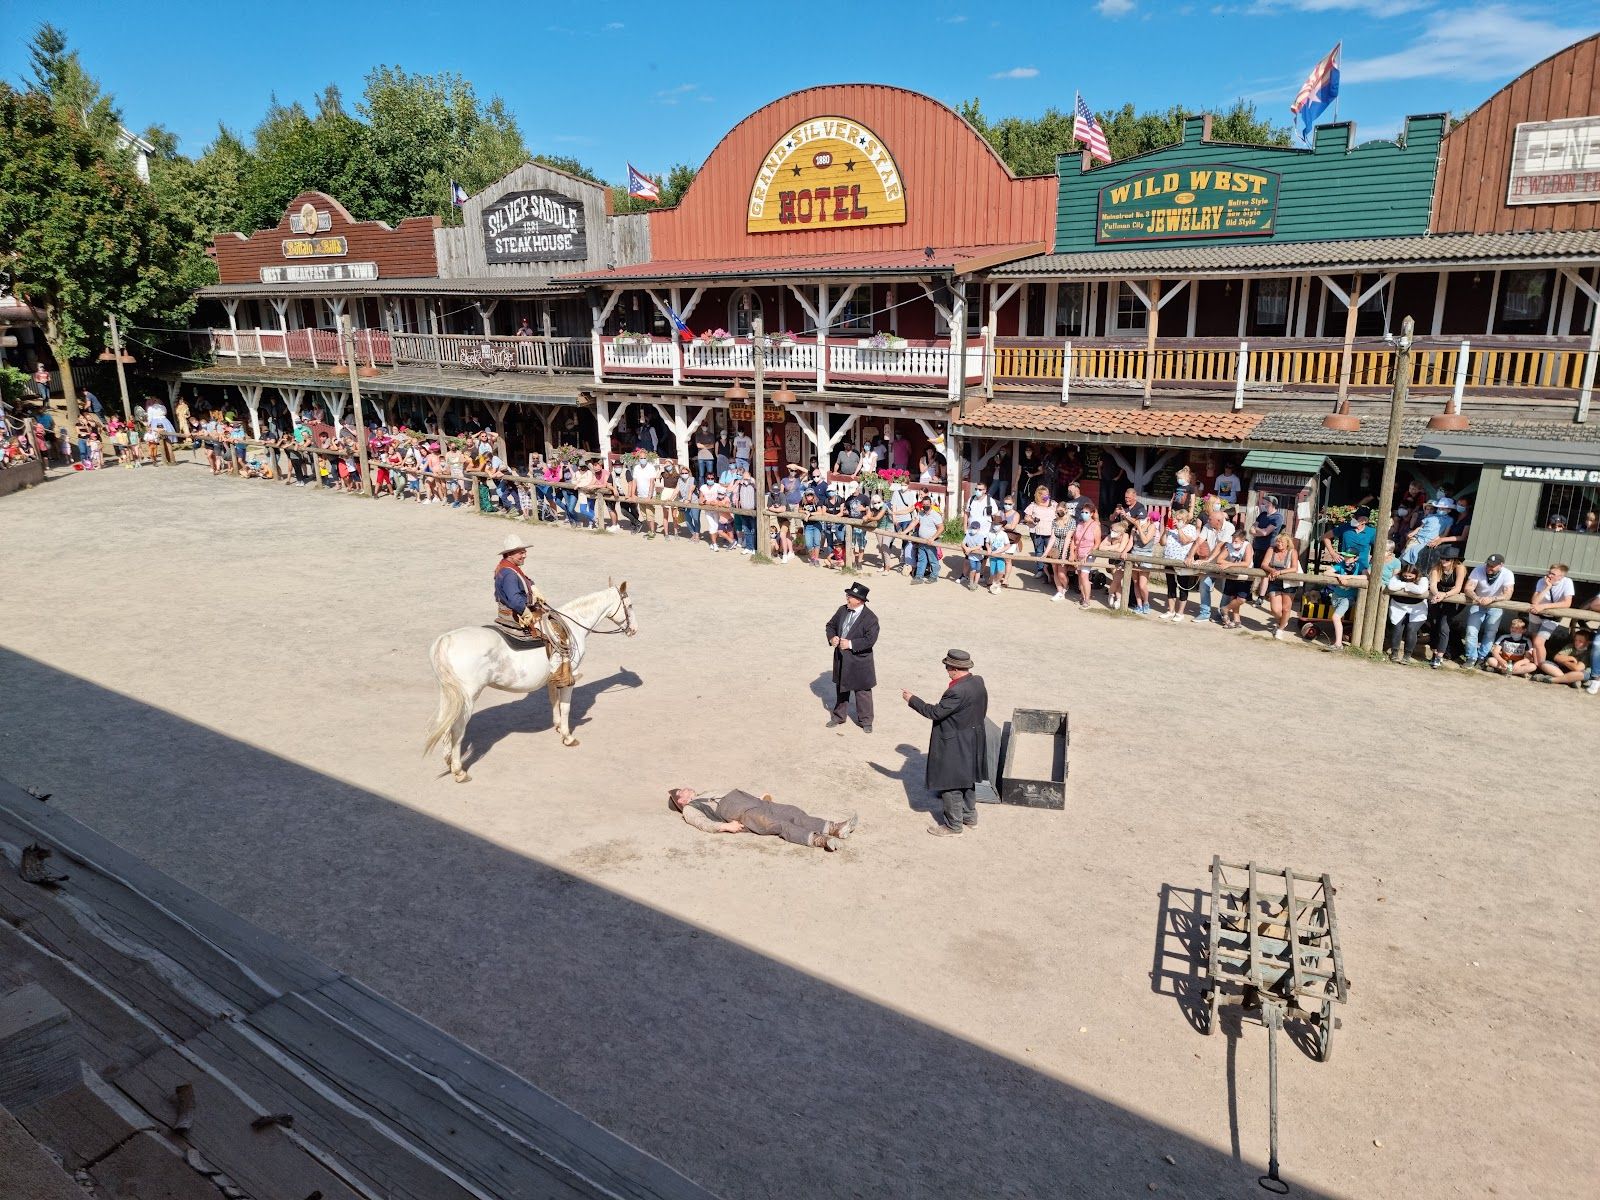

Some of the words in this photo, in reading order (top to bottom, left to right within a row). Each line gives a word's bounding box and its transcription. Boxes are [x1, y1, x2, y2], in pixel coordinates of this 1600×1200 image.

[751, 145, 787, 216] GRAND
[791, 121, 861, 148] SILVER
[865, 139, 900, 200] STAR
[1109, 172, 1180, 204] WILD
[1190, 171, 1268, 194] WEST
[778, 184, 868, 224] HOTEL
[1227, 209, 1240, 217] New
[1243, 208, 1260, 217] Style
[1250, 198, 1268, 206] Style
[488, 196, 529, 237] SILVER
[530, 195, 579, 234] SADDLE
[1147, 205, 1224, 233] JEWELRY
[1238, 218, 1256, 227] Style
[495, 233, 573, 254] STEAKHOUSE
[263, 268, 281, 282] BEST
[286, 266, 329, 280] BREAKFAST
[348, 264, 374, 279] TOWN
[1503, 464, 1587, 481] PULLMAN
